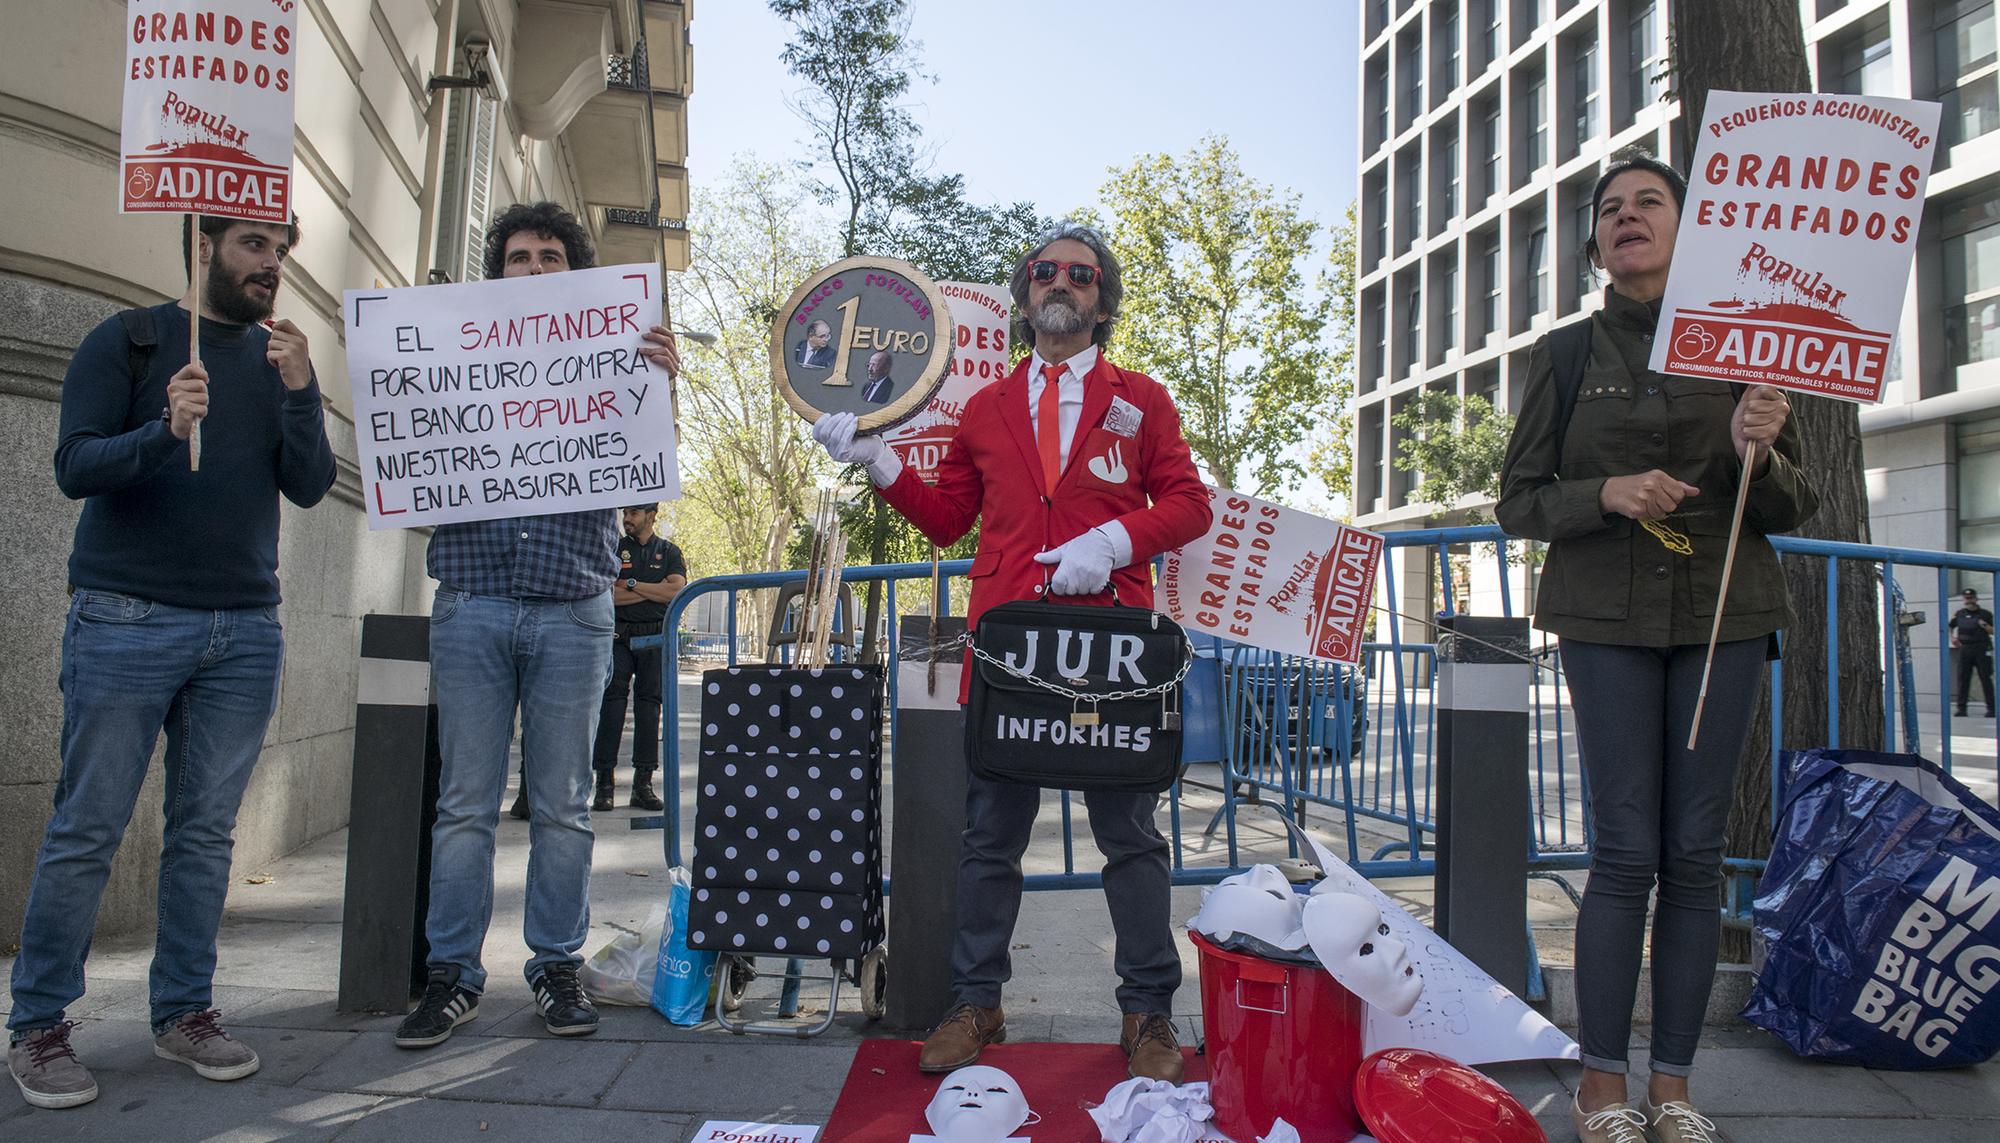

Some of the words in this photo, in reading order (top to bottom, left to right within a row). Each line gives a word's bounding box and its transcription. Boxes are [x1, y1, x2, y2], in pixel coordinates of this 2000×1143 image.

[133, 12, 290, 55] GRANDES
[131, 55, 289, 92] ESTAFADOS
[162, 90, 249, 147] Popular
[1708, 98, 1807, 138] PEQUEÑOS
[1812, 99, 1930, 150] ACCIONISTAS
[155, 167, 283, 208] ADICAE
[1705, 152, 1920, 200] GRANDES
[126, 201, 166, 209] CONSUMIDORES
[194, 203, 242, 214] RESPONSABLES
[247, 209, 283, 219] SOLIDARIOS
[1697, 200, 1912, 244] ESTAFADOS
[795, 278, 844, 325] BANCO
[865, 273, 931, 320] POPULAR
[1740, 242, 1848, 308] Popular
[396, 326, 434, 352] EL
[460, 303, 640, 350] SANTANDER
[822, 295, 860, 387] 1
[852, 325, 929, 355] EURO
[371, 367, 424, 397] POR
[428, 366, 461, 392] UN
[469, 361, 537, 391] EURO
[546, 348, 649, 387] COMPRA
[1669, 361, 1729, 375] CONSUMIDORES
[1729, 367, 1765, 380] CRÍTICOS,
[1766, 373, 1823, 388] RESPONSABLES
[1824, 381, 1830, 389] Y
[1830, 382, 1875, 396] SOLIDARIOS
[1715, 328, 1882, 384] ADICAE
[371, 412, 406, 441] EL
[411, 404, 494, 438] BANCO
[503, 390, 623, 430] POPULAR
[628, 384, 649, 415] Y
[1106, 405, 1121, 431] 500
[376, 444, 500, 480] NUESTRAS
[511, 431, 628, 468] ACCIONES
[414, 486, 446, 512] EN
[449, 484, 473, 507] LA
[484, 472, 582, 503] BASURA
[590, 454, 659, 492] ESTÁN
[1163, 558, 1184, 621] PEQUEÑOS
[1195, 496, 1250, 628] GRANDES
[1229, 505, 1280, 637] ESTAFADOS
[1266, 550, 1320, 613] Popular
[1327, 533, 1373, 637] ADICAE
[1005, 629, 1148, 685] JUR
[997, 715, 1152, 752] INFORMES
[1891, 899, 2000, 994] BIG
[1874, 942, 1983, 1023] BLUE
[1851, 978, 1959, 1058] BAG
